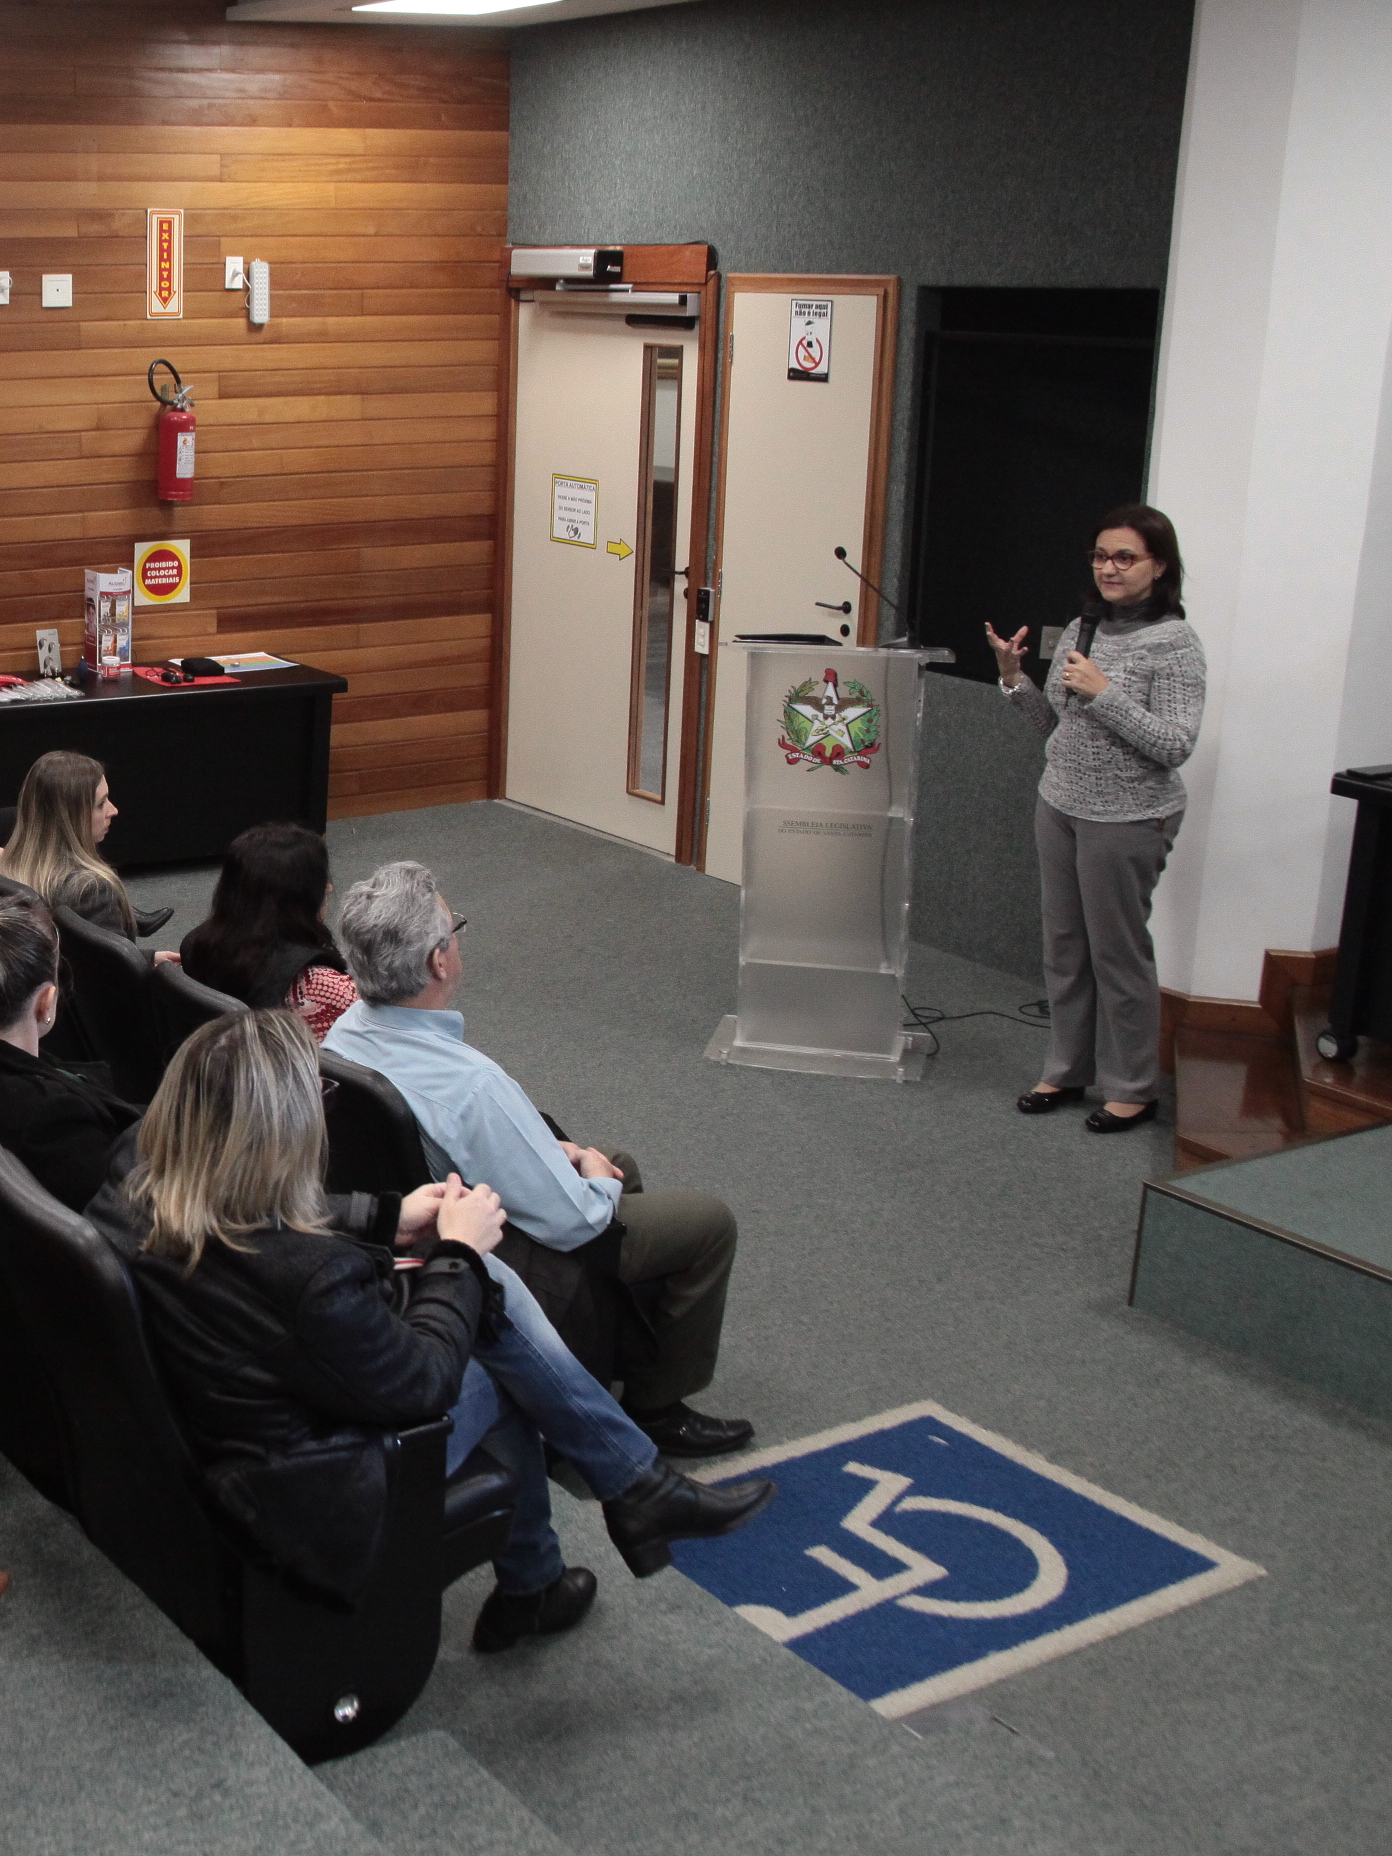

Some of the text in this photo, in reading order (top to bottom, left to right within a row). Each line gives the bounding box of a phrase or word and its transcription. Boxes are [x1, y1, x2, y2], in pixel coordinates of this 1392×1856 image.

[161, 222, 170, 298] EXTINTOR
[795, 302, 814, 310] Fumar
[812, 310, 828, 318] legal
[145, 577, 179, 585] MATERIAIS
[788, 753, 812, 762] ESTADO
[844, 756, 870, 764] CATARINA
[825, 822, 872, 830] LEGISLATIVA
